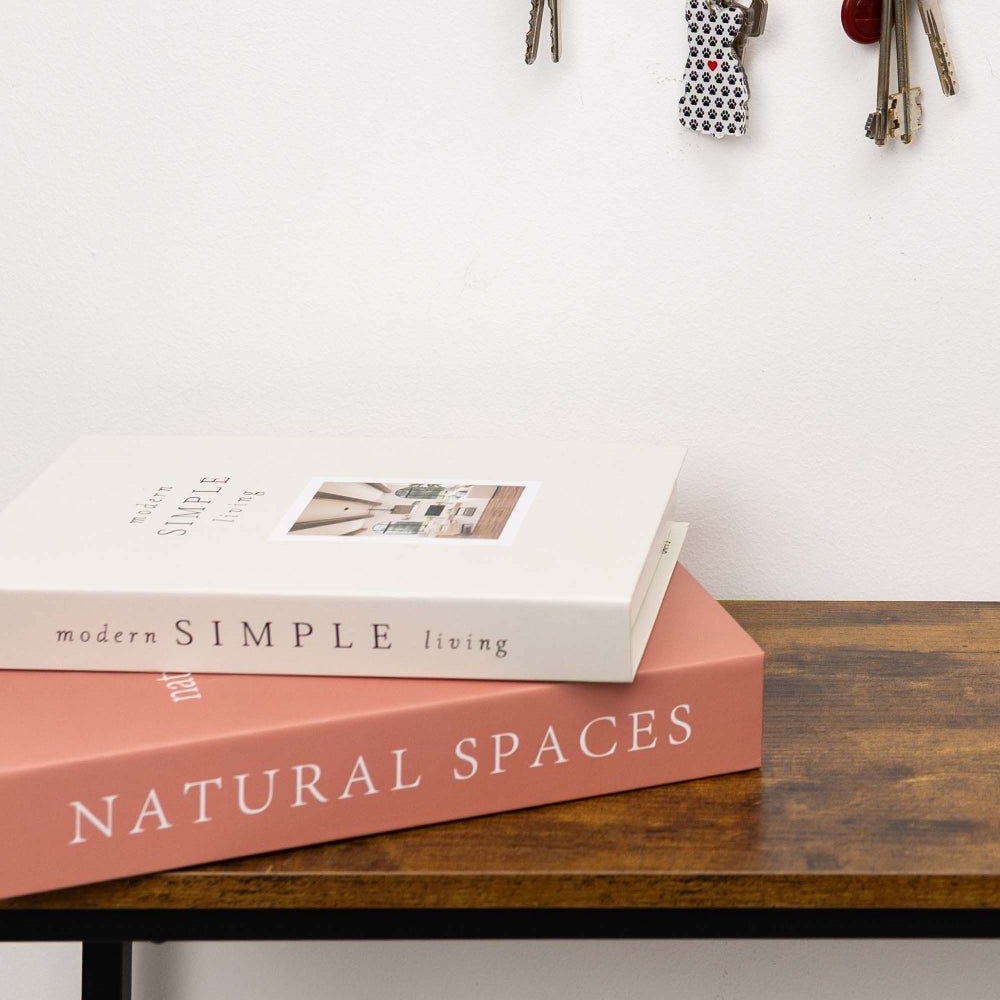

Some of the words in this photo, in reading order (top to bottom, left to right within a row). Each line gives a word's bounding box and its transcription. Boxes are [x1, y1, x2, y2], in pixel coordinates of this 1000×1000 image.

[129, 486, 173, 524] modern
[157, 477, 230, 536] SIMPLE
[212, 491, 265, 523] living
[55, 624, 158, 644] modern
[174, 618, 393, 650] SIMPLE
[424, 630, 509, 658] living
[69, 748, 422, 846] NATURAL
[452, 703, 694, 781] SPACES
